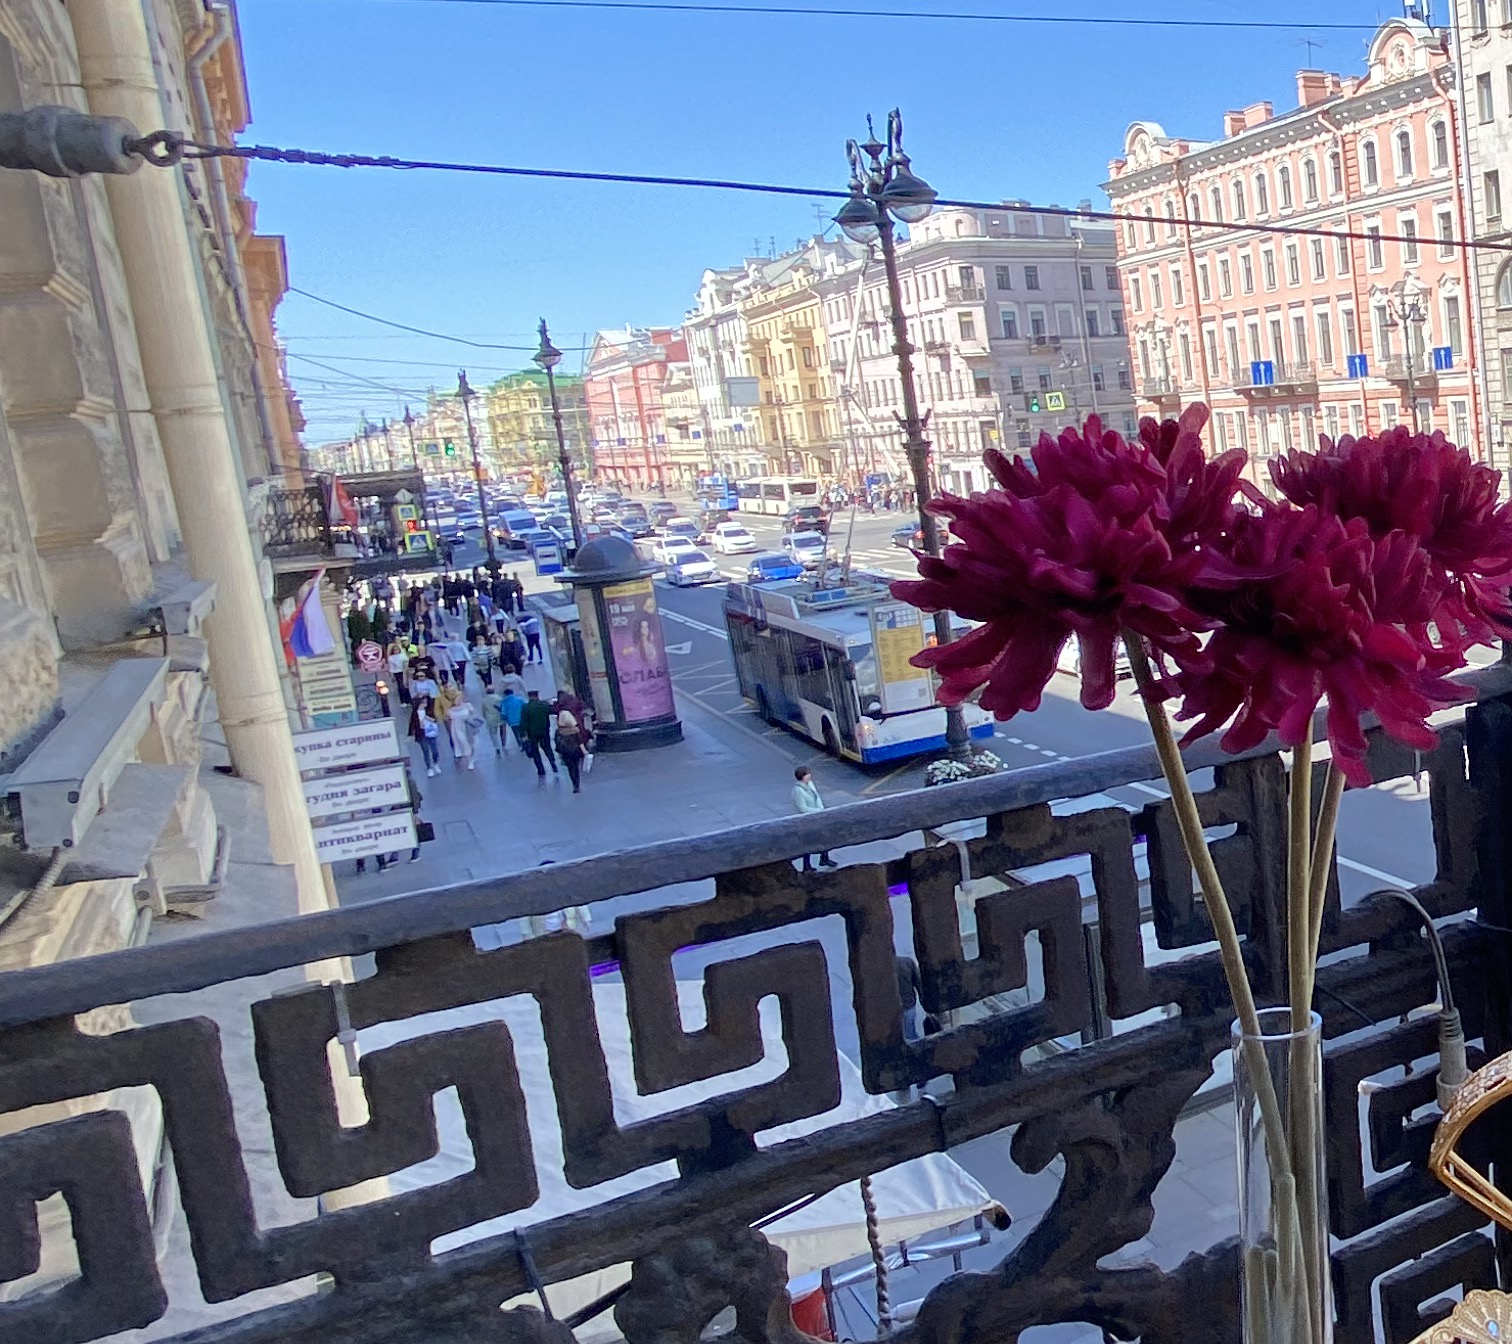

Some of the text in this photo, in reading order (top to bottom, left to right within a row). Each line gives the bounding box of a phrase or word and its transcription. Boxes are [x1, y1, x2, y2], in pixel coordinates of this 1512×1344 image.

[294, 731, 392, 755] купка старины
[305, 790, 348, 805] тудия
[353, 780, 402, 795] загара
[315, 826, 409, 849] нтиквариат
